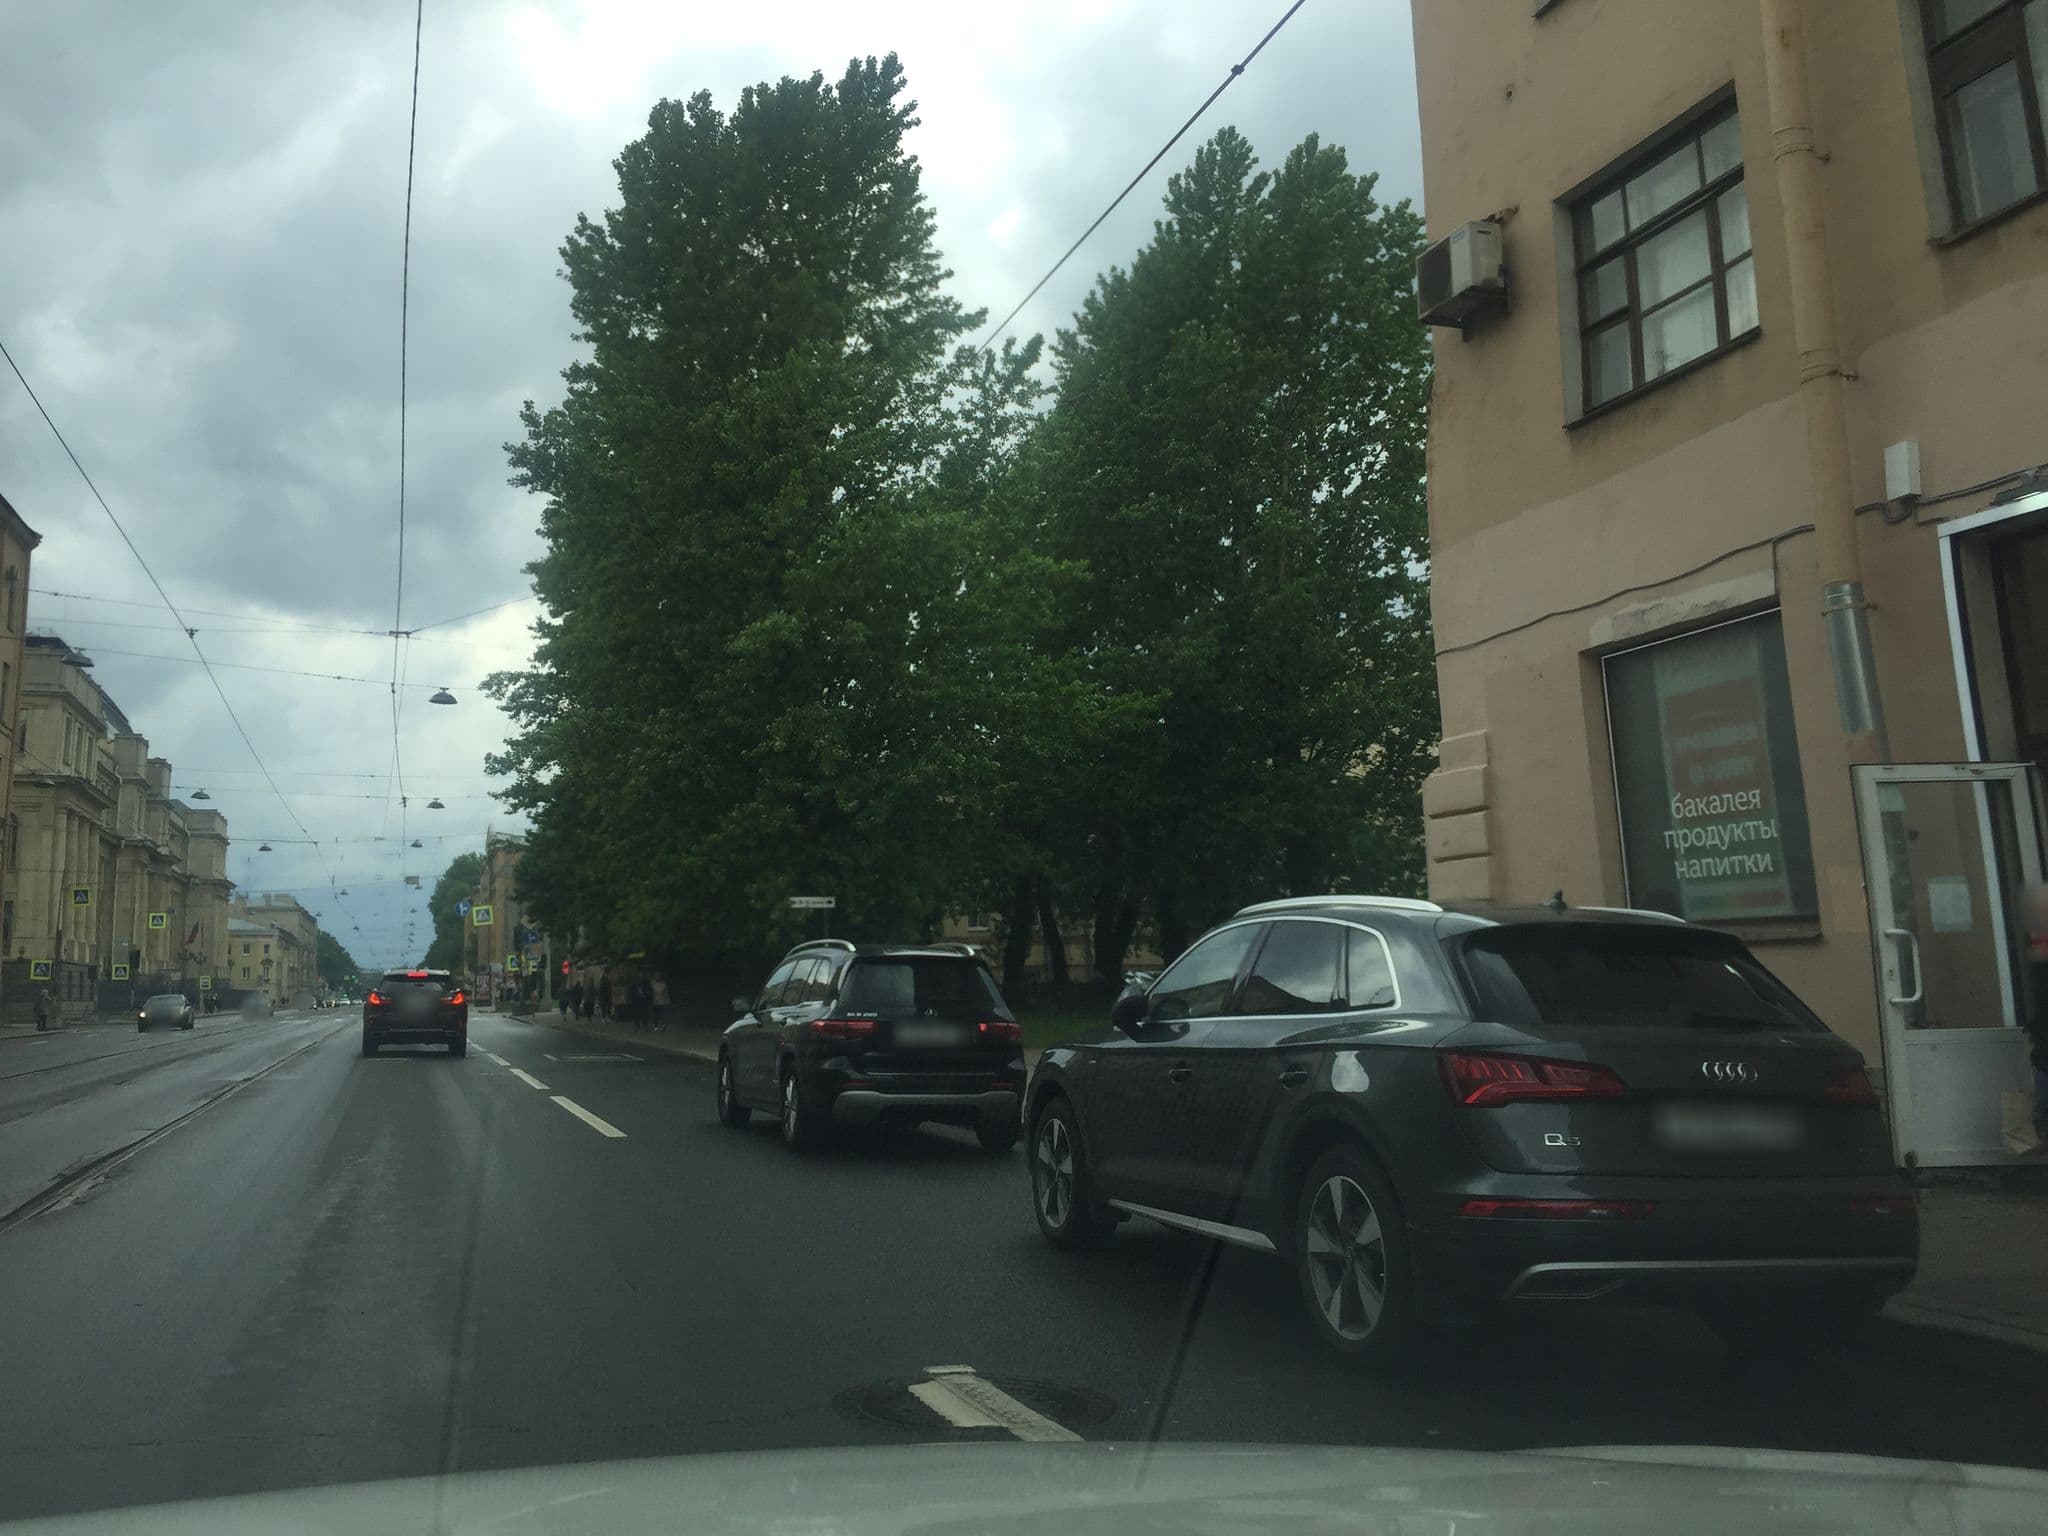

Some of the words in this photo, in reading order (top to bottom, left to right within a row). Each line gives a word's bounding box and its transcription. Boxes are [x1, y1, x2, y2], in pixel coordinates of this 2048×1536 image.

[1671, 789, 1761, 819] бакалея
[1664, 818, 1778, 854] продукты
[1674, 852, 1774, 879] напитки
[1544, 1133, 1581, 1146] Q5
